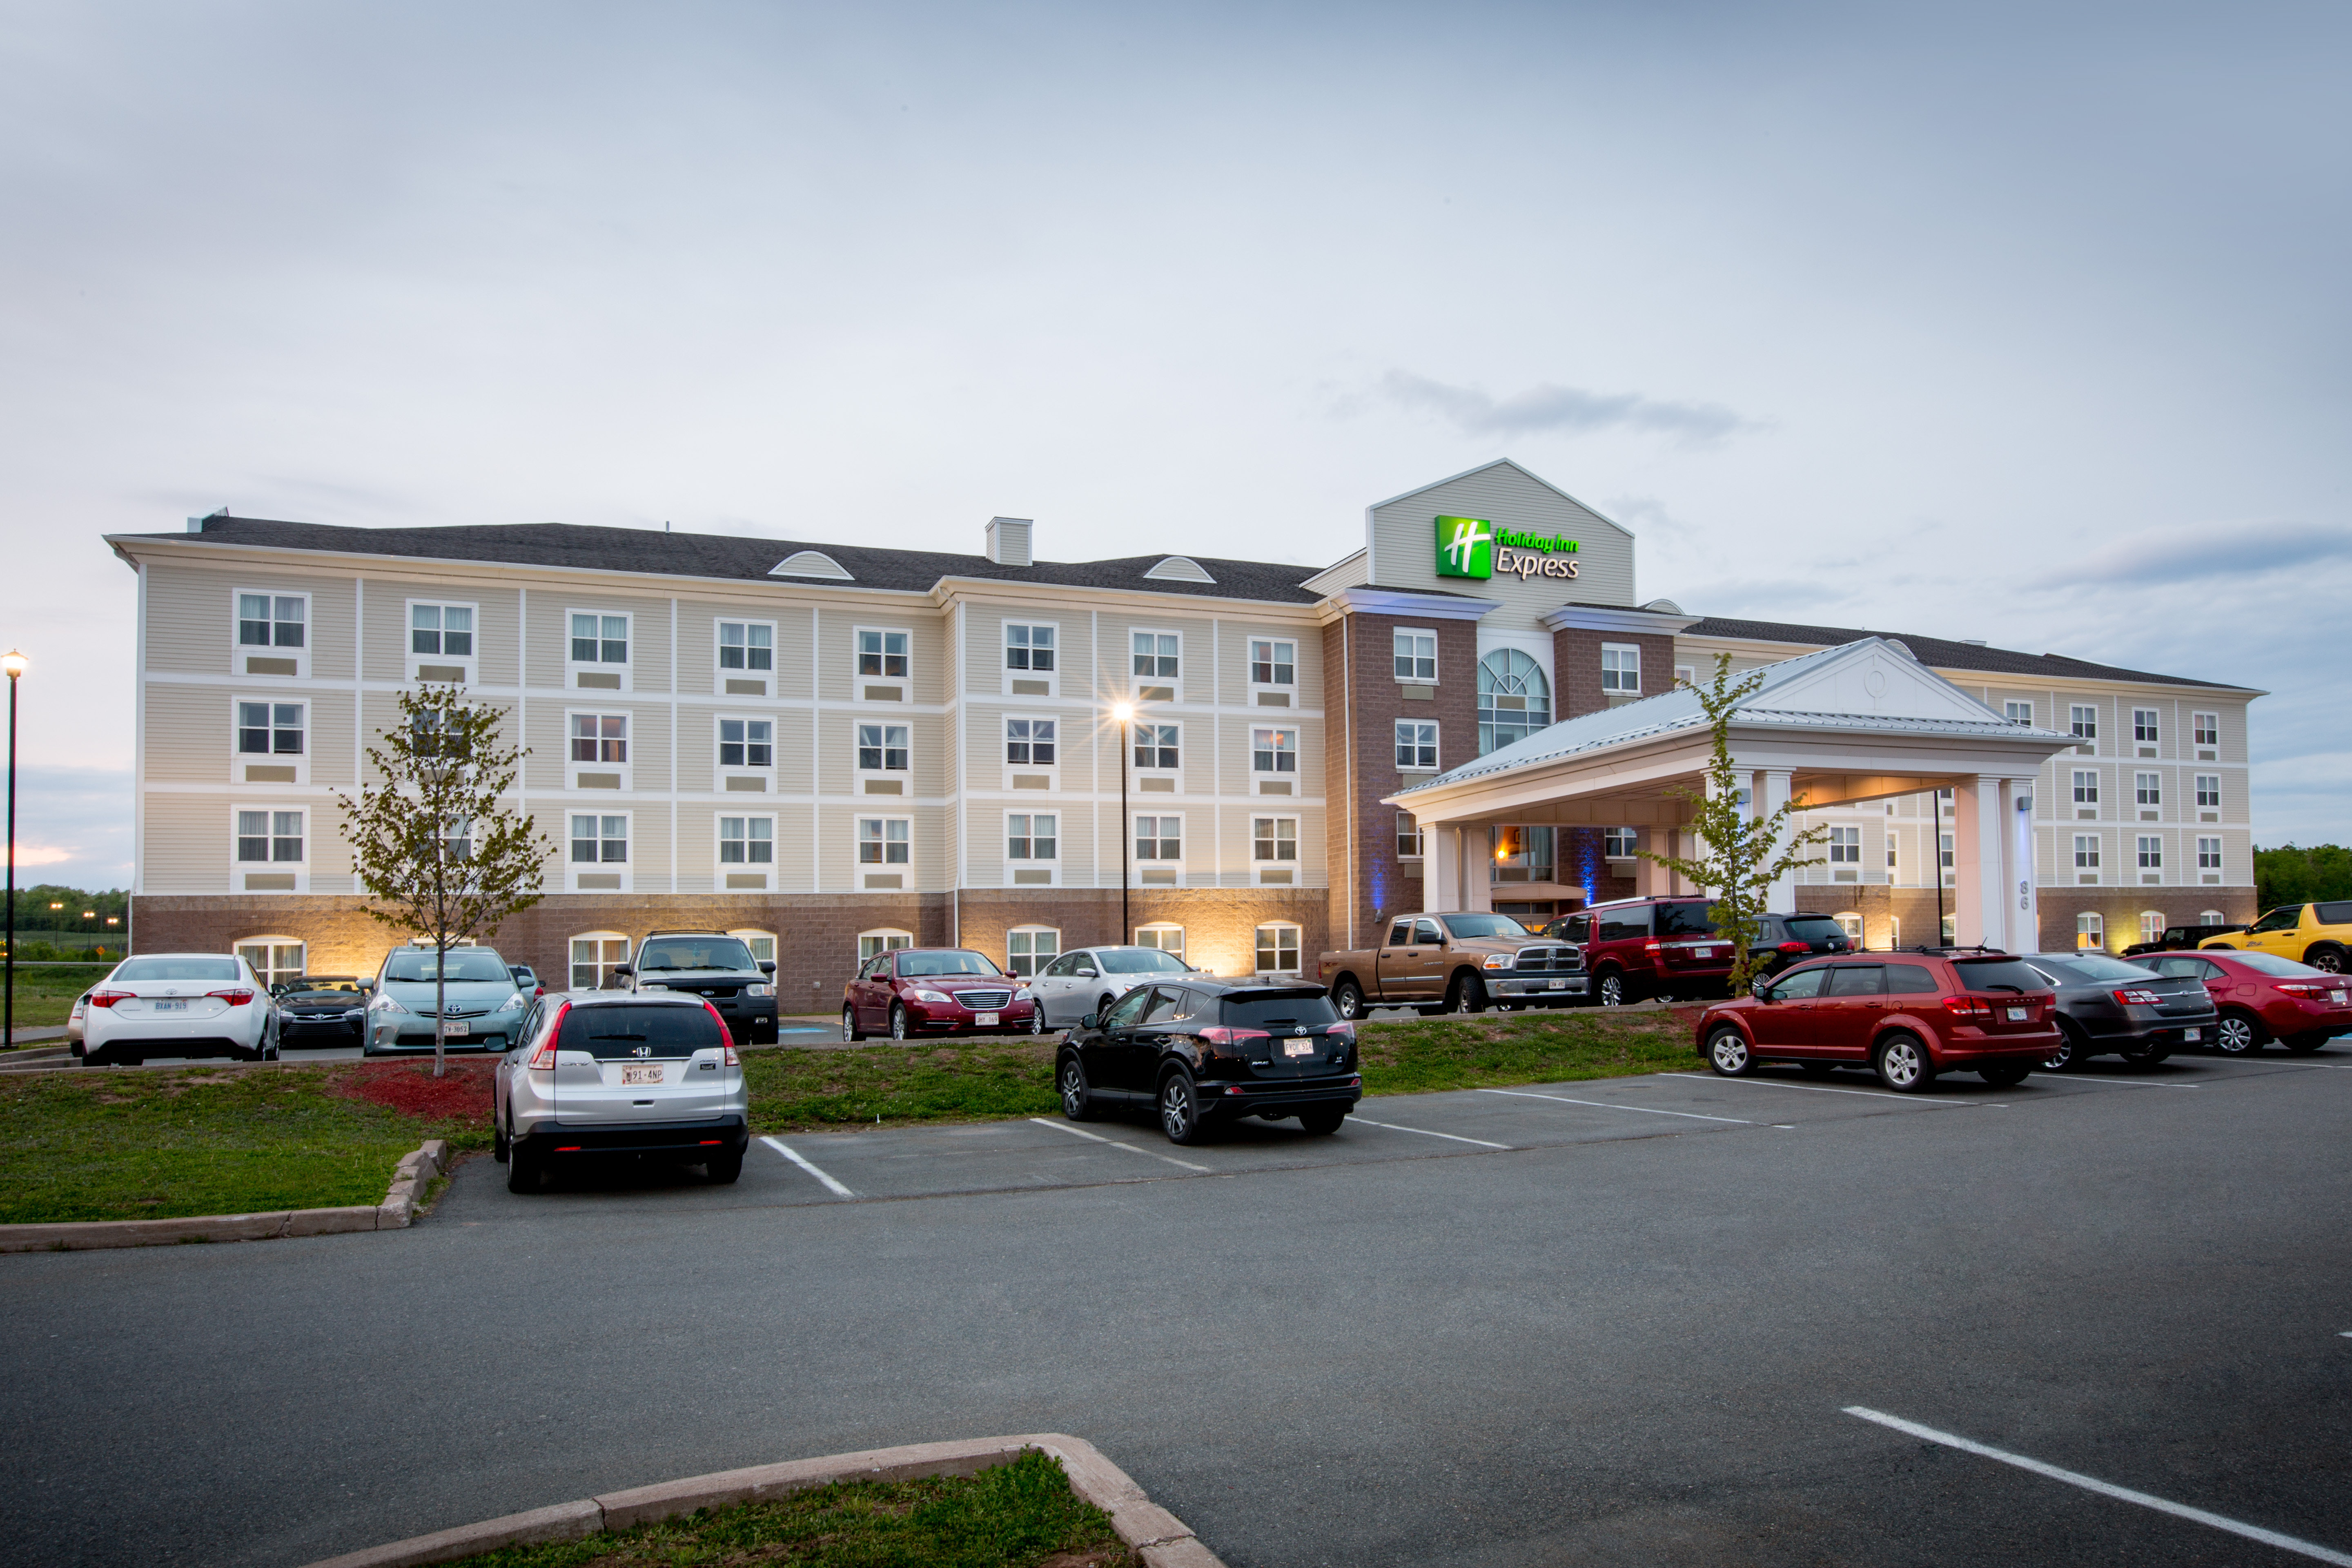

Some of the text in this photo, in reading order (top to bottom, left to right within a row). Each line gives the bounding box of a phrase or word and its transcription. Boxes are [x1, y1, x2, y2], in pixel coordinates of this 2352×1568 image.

[1495, 527, 1579, 554] Holiday Inn
[1495, 548, 1579, 581] Express
